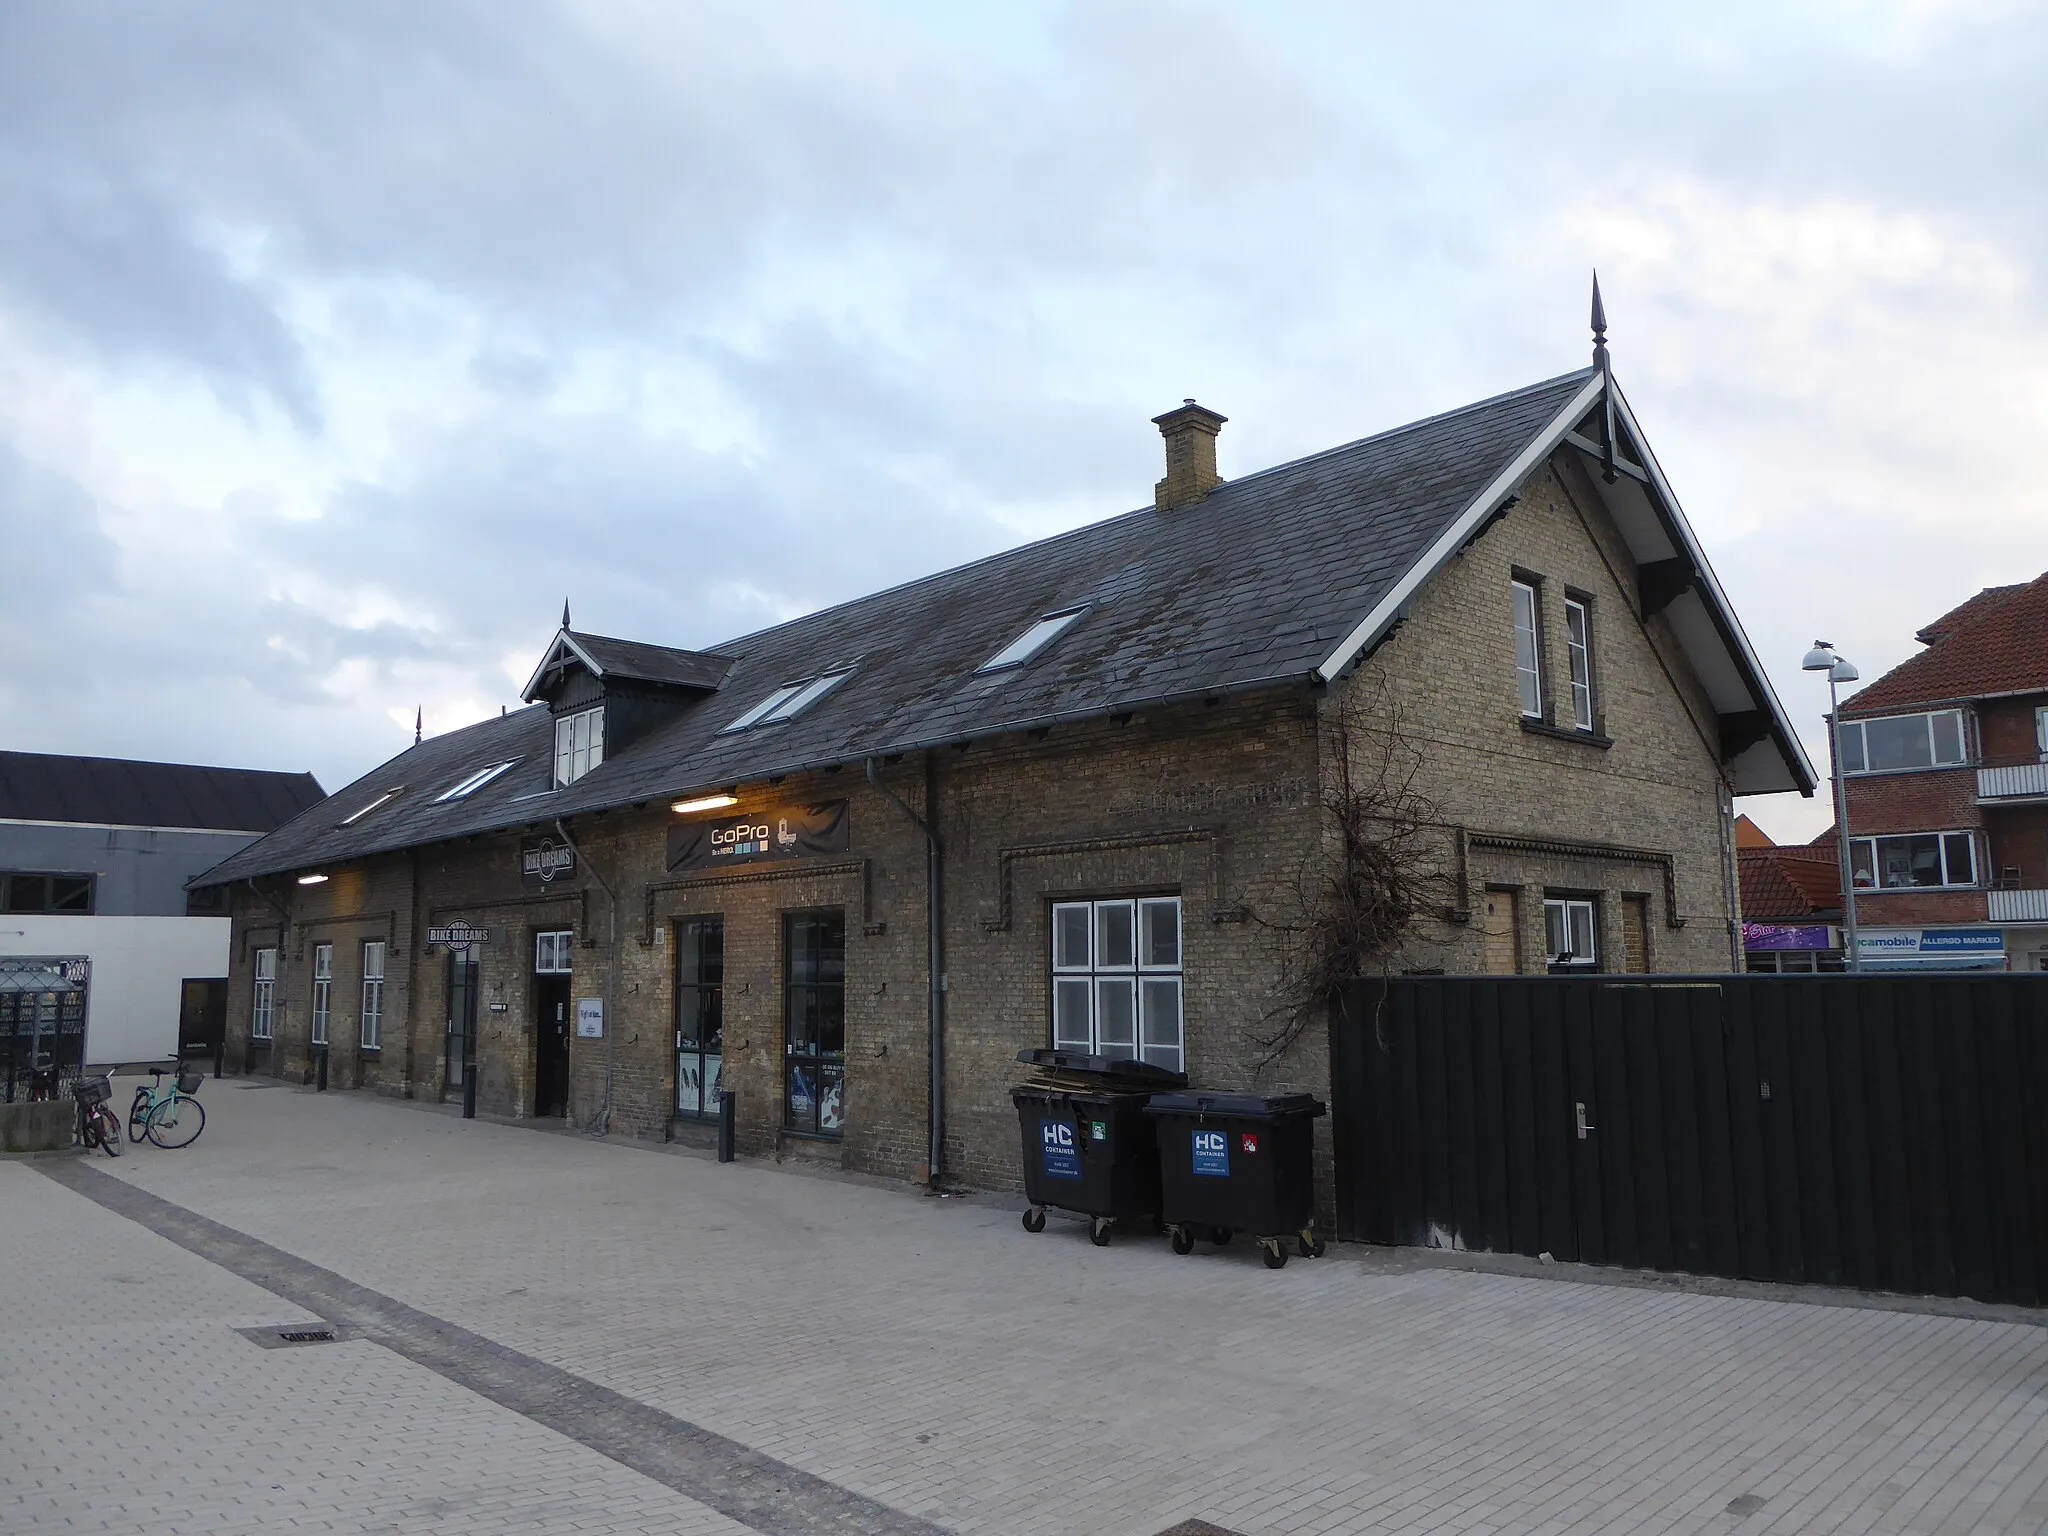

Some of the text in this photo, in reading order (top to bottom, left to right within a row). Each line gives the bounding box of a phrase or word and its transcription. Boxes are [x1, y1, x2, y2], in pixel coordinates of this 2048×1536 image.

[711, 824, 769, 844] GoPro
[526, 848, 570, 870] BIKE DREAMS
[430, 930, 488, 941] BIKE DREAMS
[1963, 936, 2000, 944] MARKED
[1044, 1124, 1073, 1146] HC
[1195, 1133, 1224, 1150] HC
[1045, 1146, 1075, 1155] CONTAINER
